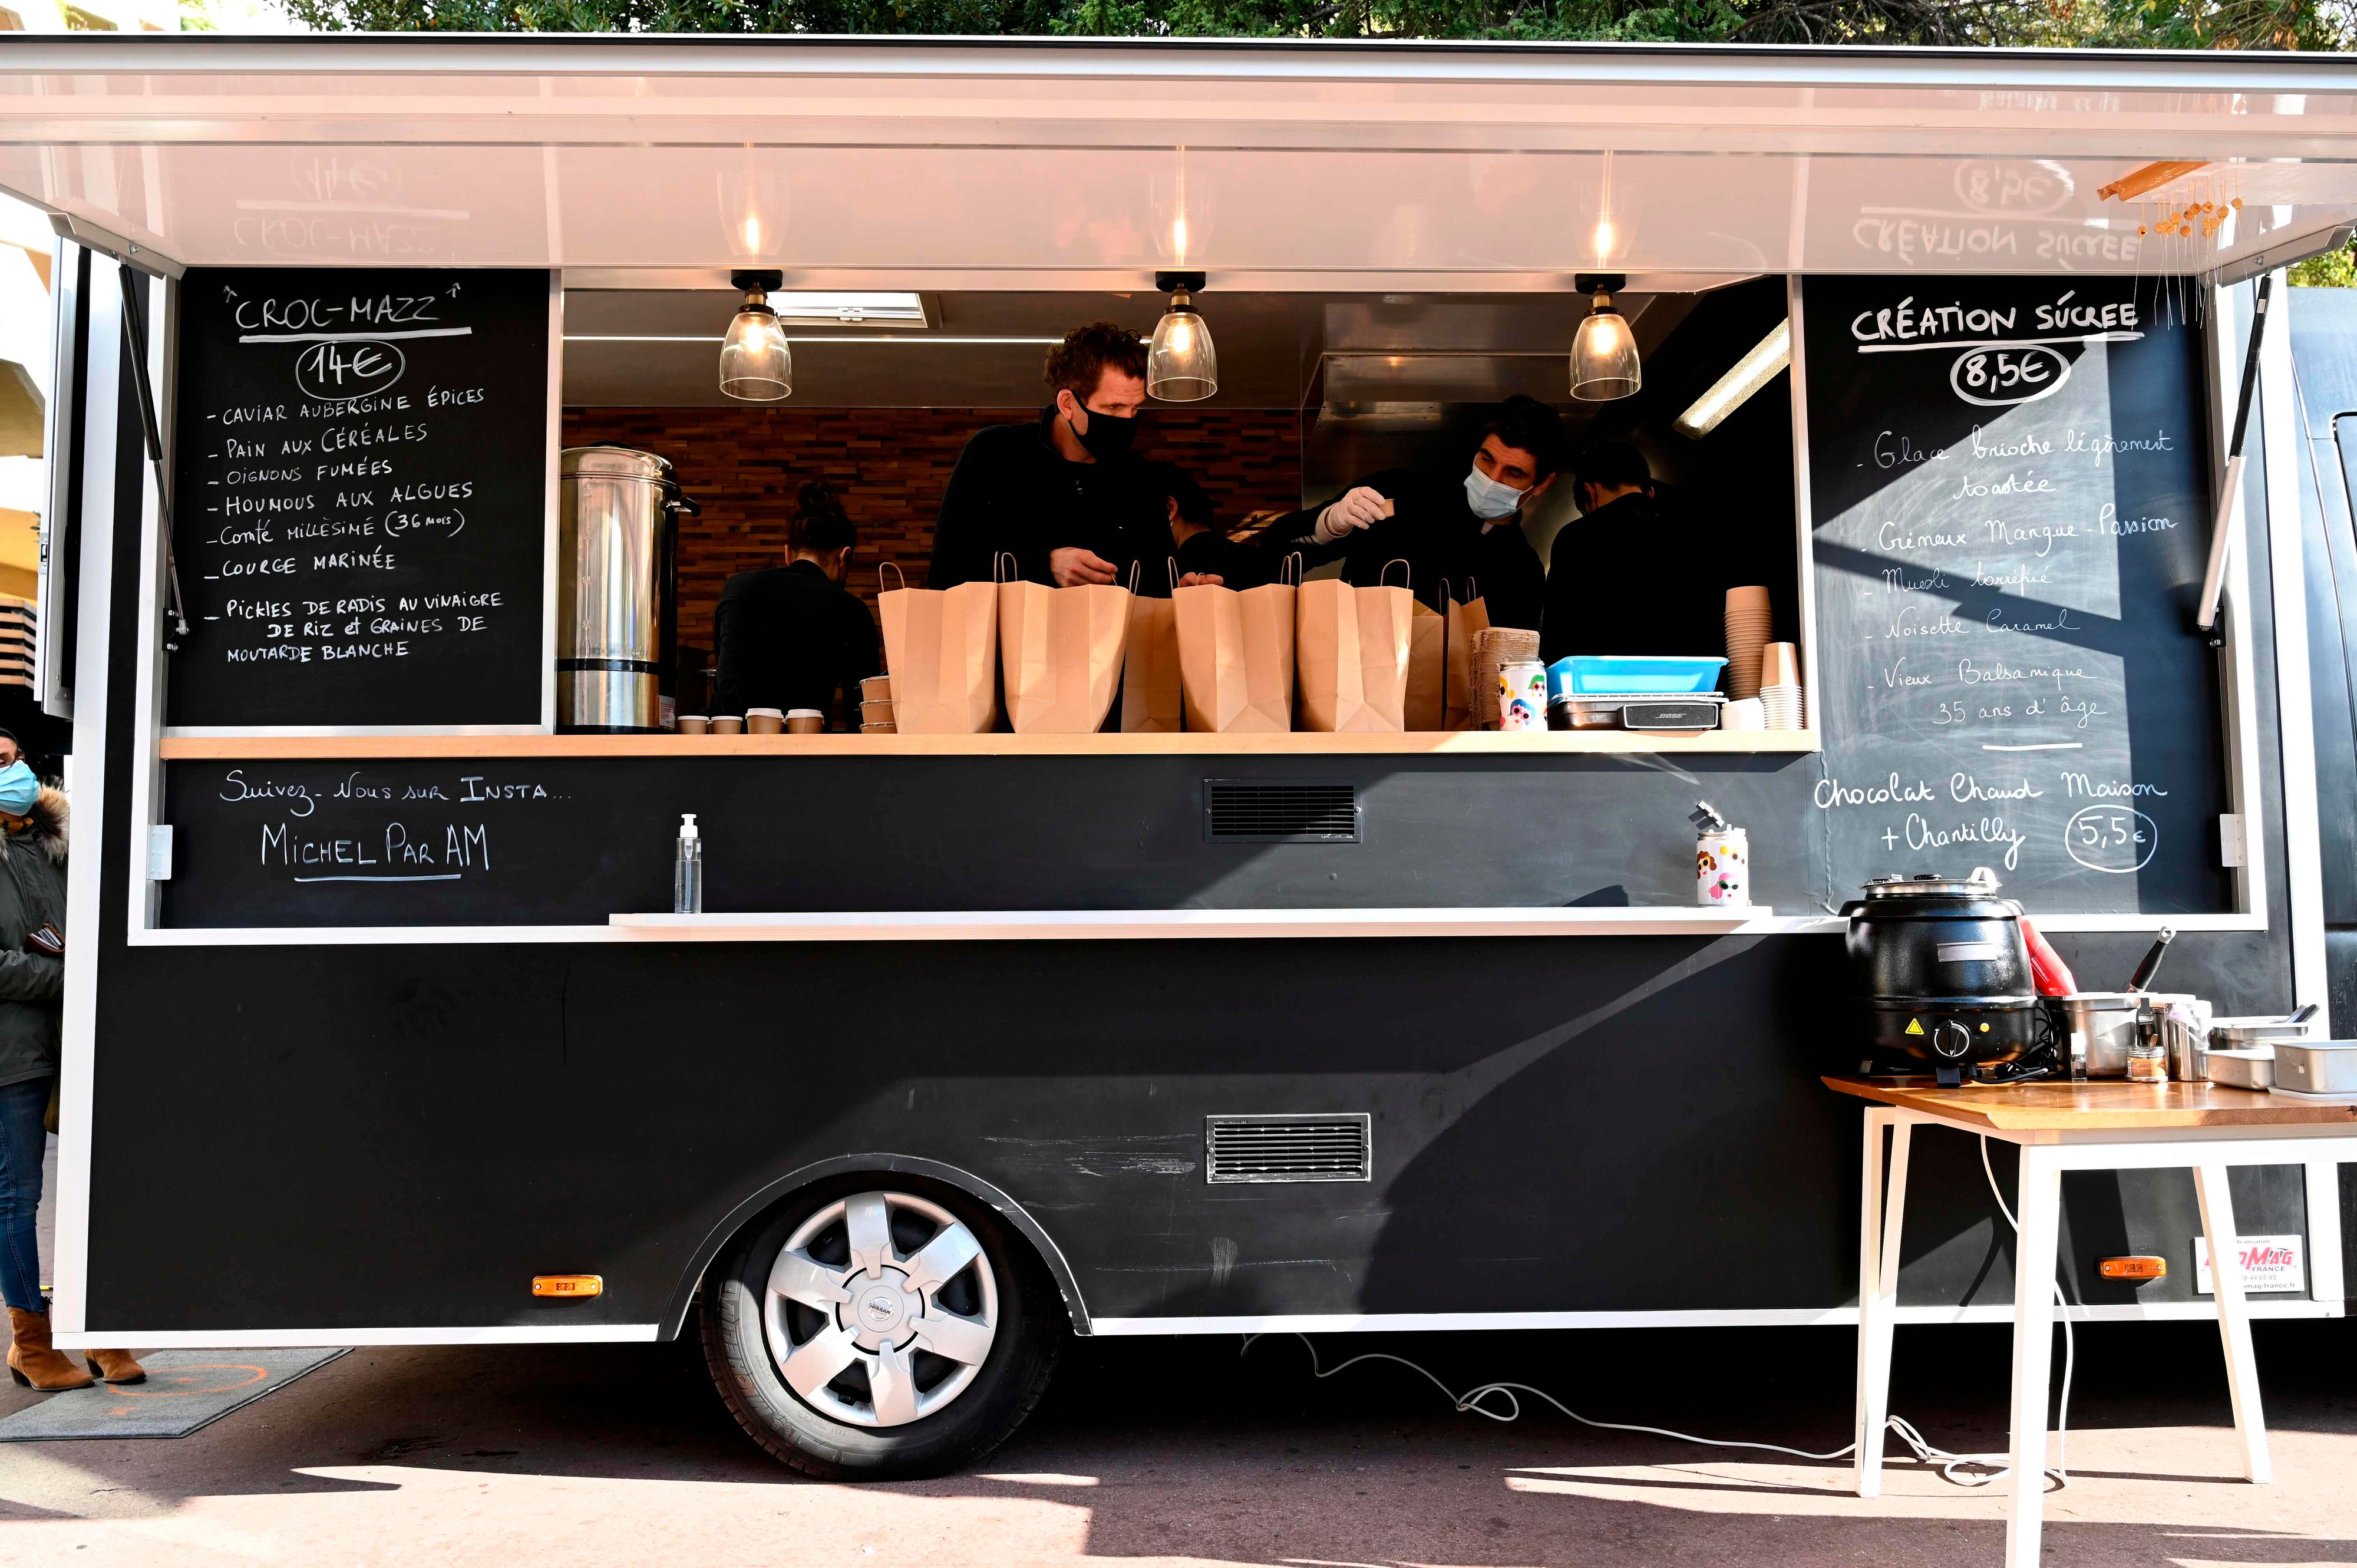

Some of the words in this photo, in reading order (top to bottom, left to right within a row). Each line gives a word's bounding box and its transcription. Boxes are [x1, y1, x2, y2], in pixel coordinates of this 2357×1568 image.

[1850, 295, 2018, 341] CRÉATION
[306, 345, 393, 385] 14€
[1966, 350, 2052, 394] 8,5€
[223, 404, 288, 425] CAVIAR
[299, 395, 411, 419] AUBERGINE
[427, 385, 484, 408] ÉPICES
[226, 438, 265, 459] PAIN
[281, 439, 312, 456] AUX
[321, 422, 427, 453] CÉRÉALES
[1873, 429, 1952, 470] Glace
[1971, 423, 2056, 458] brioche
[2064, 428, 2174, 468] légèrement
[227, 467, 302, 485] OIGNONS
[316, 455, 392, 481] FUMÉES
[1953, 470, 2057, 500] toastée
[226, 494, 315, 517] HOUMOUS
[336, 490, 374, 508] AUX
[390, 481, 473, 503] ALGUES
[220, 519, 274, 545] Comté
[1879, 521, 1968, 551] Crémeux
[222, 557, 297, 577] COURGE
[313, 544, 397, 570] MARINÉE
[1970, 560, 2054, 597] torréfié
[302, 600, 332, 615] DE
[336, 595, 386, 615] RADIS
[399, 597, 418, 612] AU
[424, 591, 504, 609] VINAIGRE
[266, 623, 295, 638] DE
[303, 620, 335, 637] RIZ
[344, 616, 362, 635] et
[370, 617, 443, 635] GRAINES
[457, 616, 488, 632] DE
[1885, 606, 1970, 638] Noisette
[1986, 608, 2080, 633] Caramel
[227, 643, 313, 663] MOUTARDE
[321, 641, 410, 661] BLANCHE
[1884, 656, 1932, 688] Vieux
[1958, 658, 2098, 691] Balsamique
[1932, 701, 1966, 724] 35
[1978, 704, 2012, 719] ans
[2061, 695, 2108, 728] âge
[401, 787, 450, 800] sur
[1814, 772, 1935, 809] Chocolat
[1950, 772, 2044, 803] Chaud
[2061, 771, 2168, 797] Maison
[262, 821, 377, 866] MICHEL
[446, 823, 490, 871] AM
[2078, 816, 2146, 849] 5,5€
[869, 1304, 892, 1315] NISSAN
